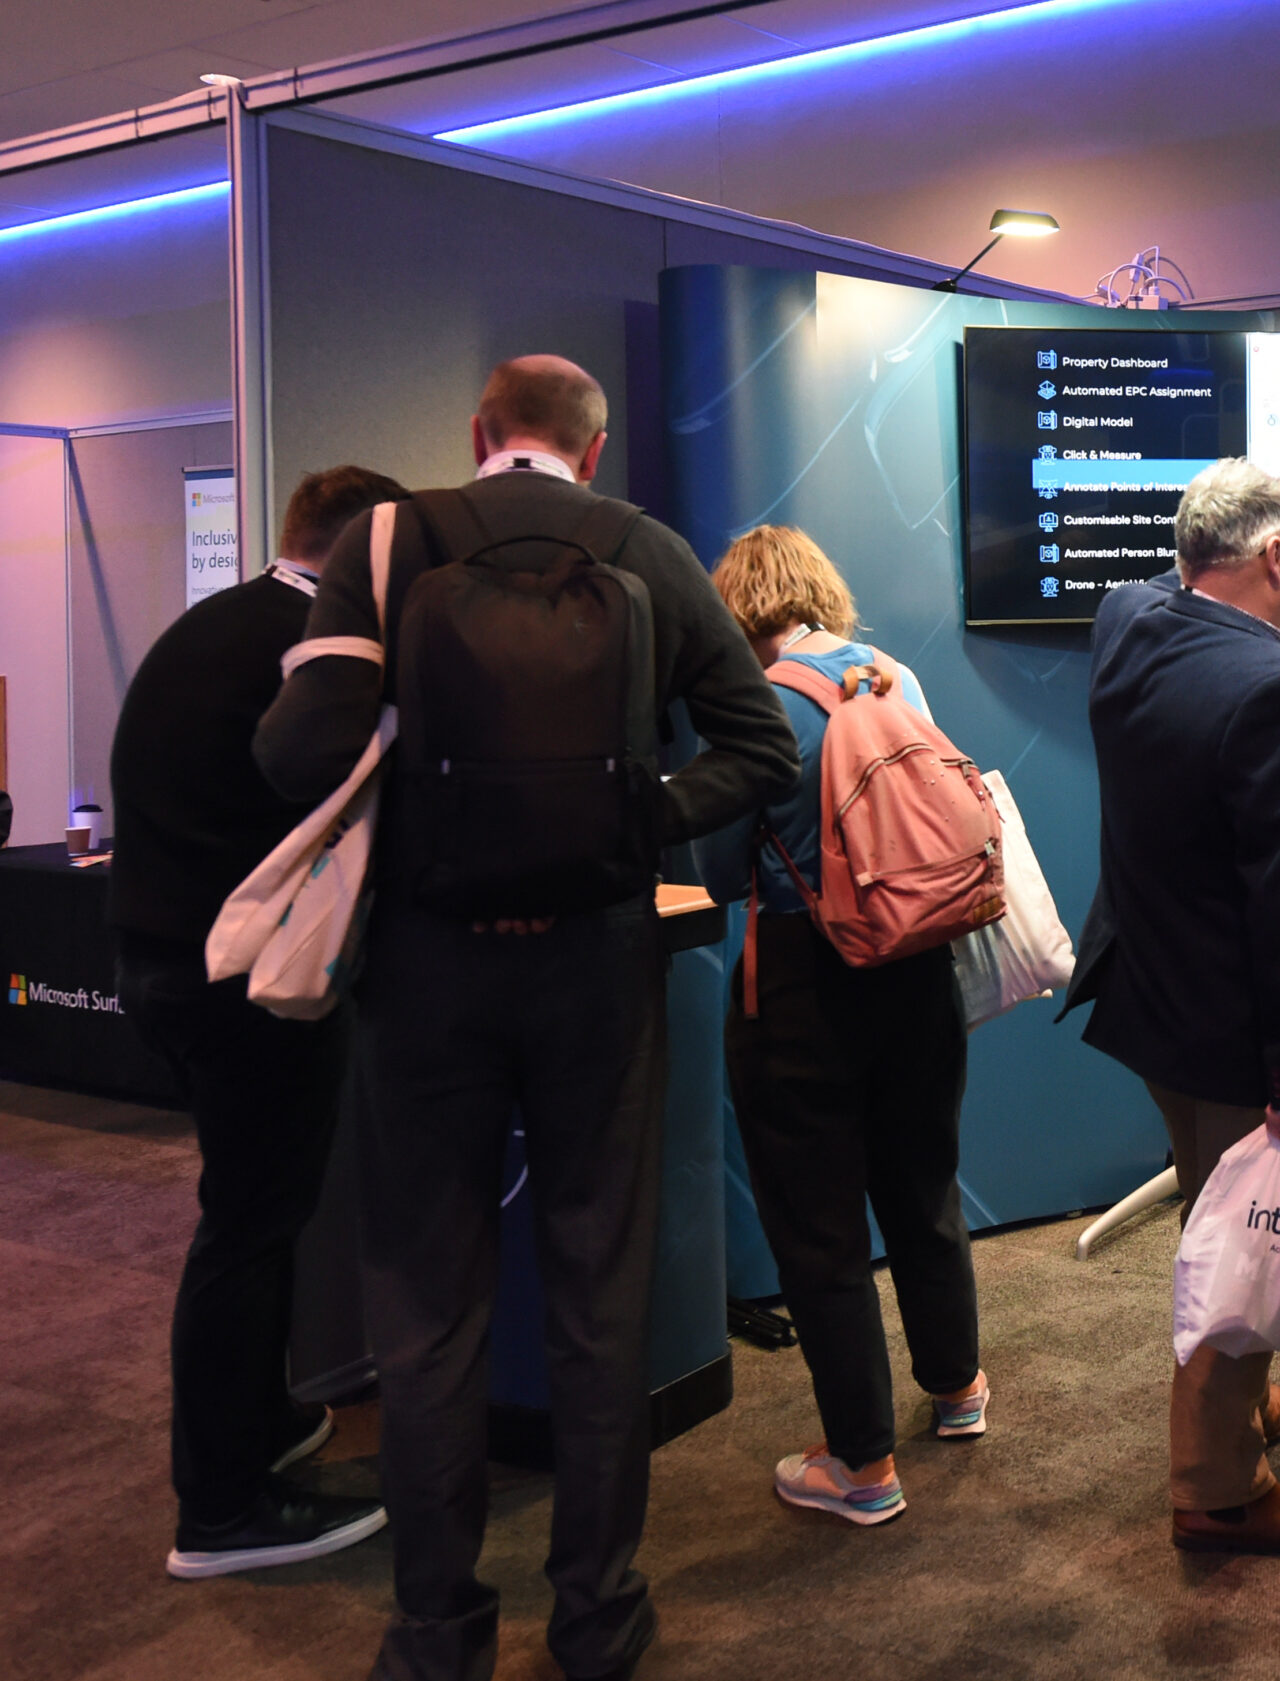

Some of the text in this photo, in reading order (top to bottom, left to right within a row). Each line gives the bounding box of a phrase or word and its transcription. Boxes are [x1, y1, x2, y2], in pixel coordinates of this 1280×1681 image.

[1062, 356, 1168, 369] Property Dashboard
[1062, 385, 1212, 398] Automated EPC Assignment
[1063, 416, 1133, 429] Digital Model
[1063, 450, 1142, 460] Click & Measure
[1063, 482, 1109, 492] Annotate
[1110, 482, 1141, 492] Points
[1143, 482, 1153, 492] of
[1063, 514, 1131, 525] Customisable
[1132, 514, 1152, 525] Site
[192, 529, 238, 547] Inclusiv
[1064, 548, 1120, 559] Automated
[1121, 548, 1155, 558] Person
[192, 553, 205, 573] by
[1065, 580, 1095, 590] Drone
[29, 982, 125, 1014] Microsoft Surf
